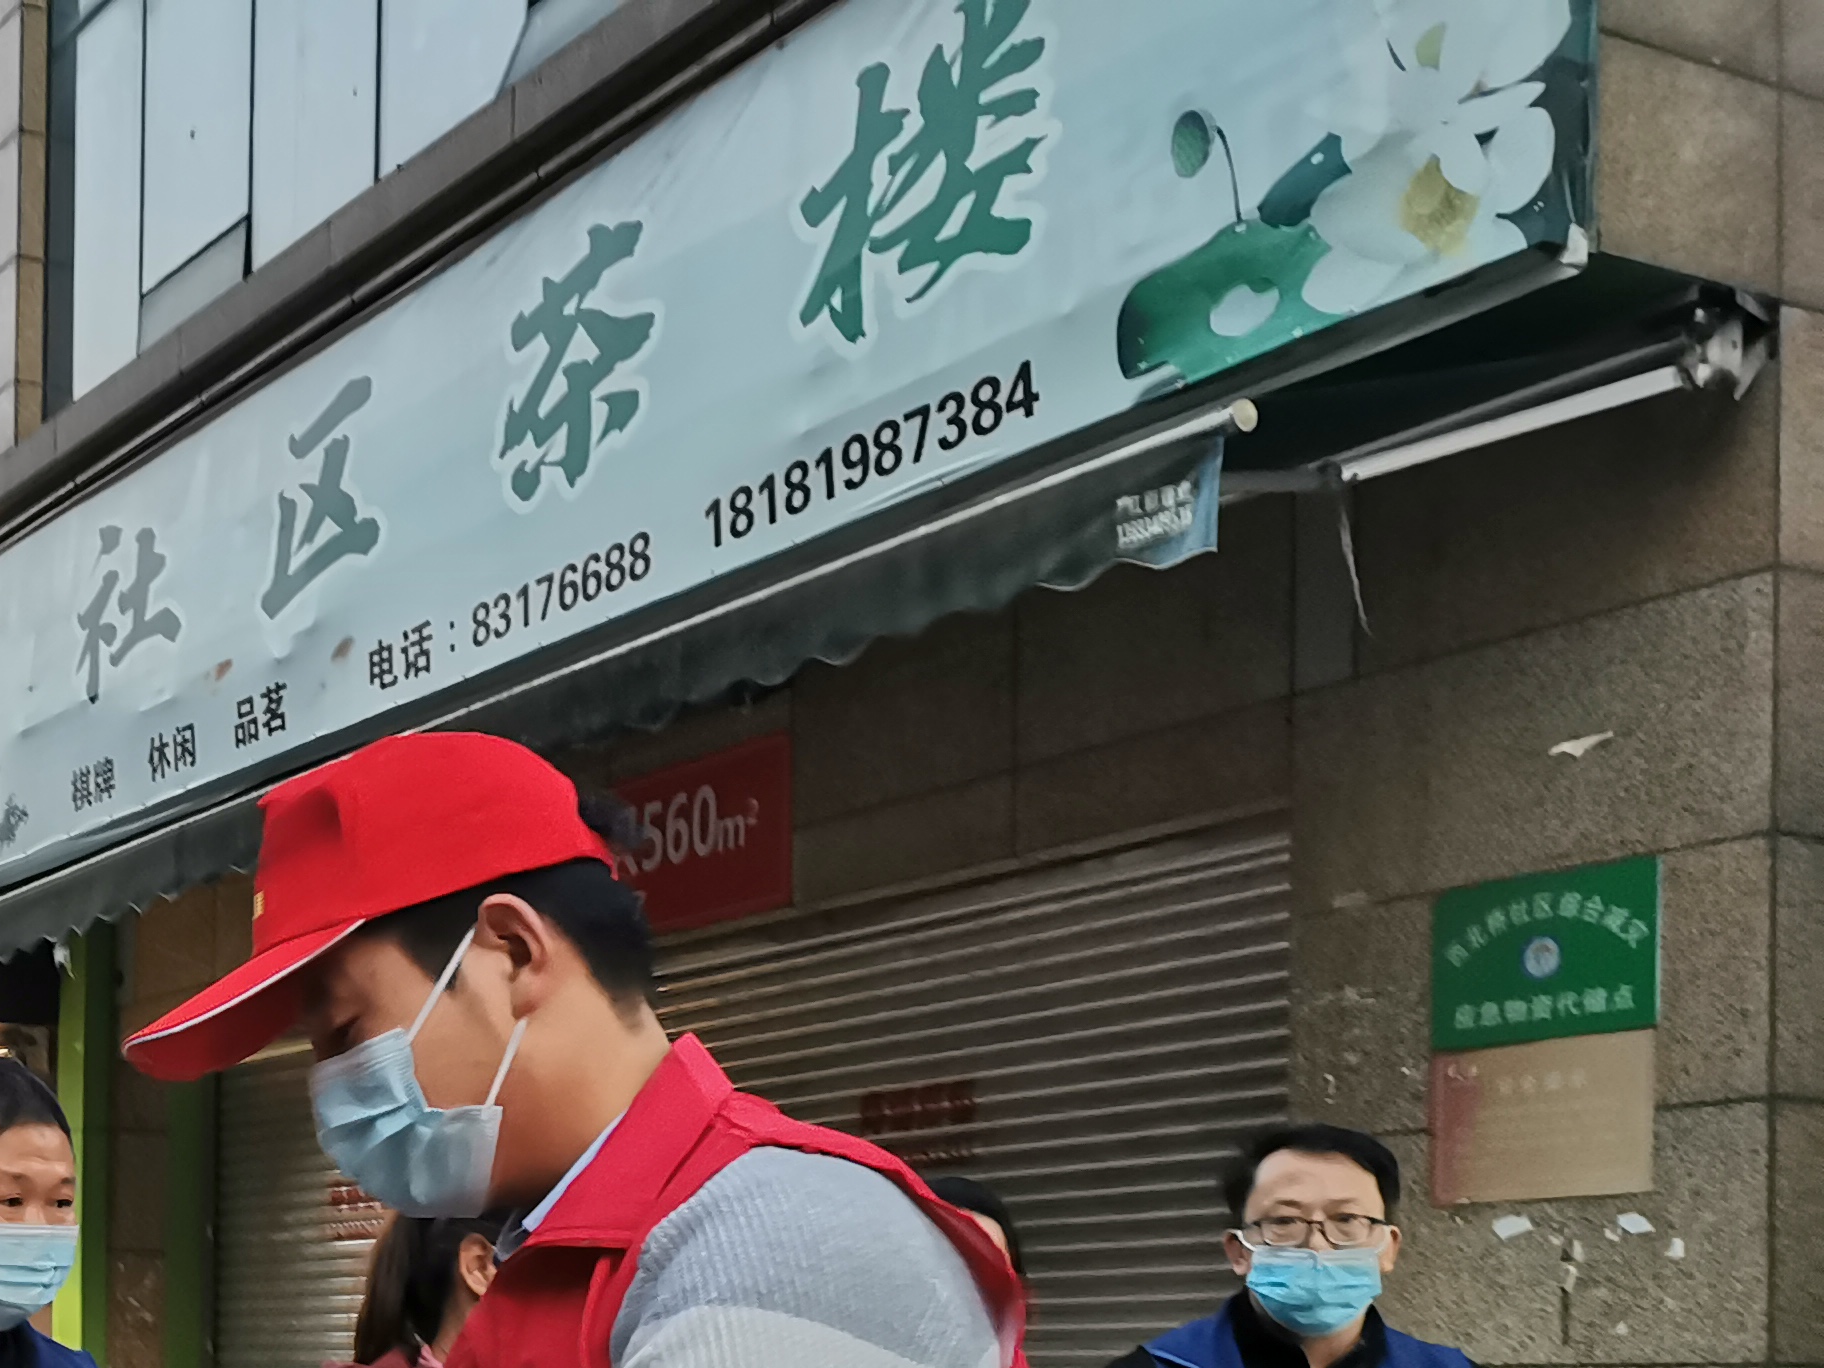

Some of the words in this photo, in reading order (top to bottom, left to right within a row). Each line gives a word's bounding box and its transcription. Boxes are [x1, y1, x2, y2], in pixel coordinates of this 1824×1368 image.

[76, 0, 1047, 703] 社区茶楼
[703, 360, 1040, 550] 18181987384
[70, 756, 117, 813] 棋牌
[147, 723, 197, 783] 休闲
[234, 682, 288, 749] 品茗
